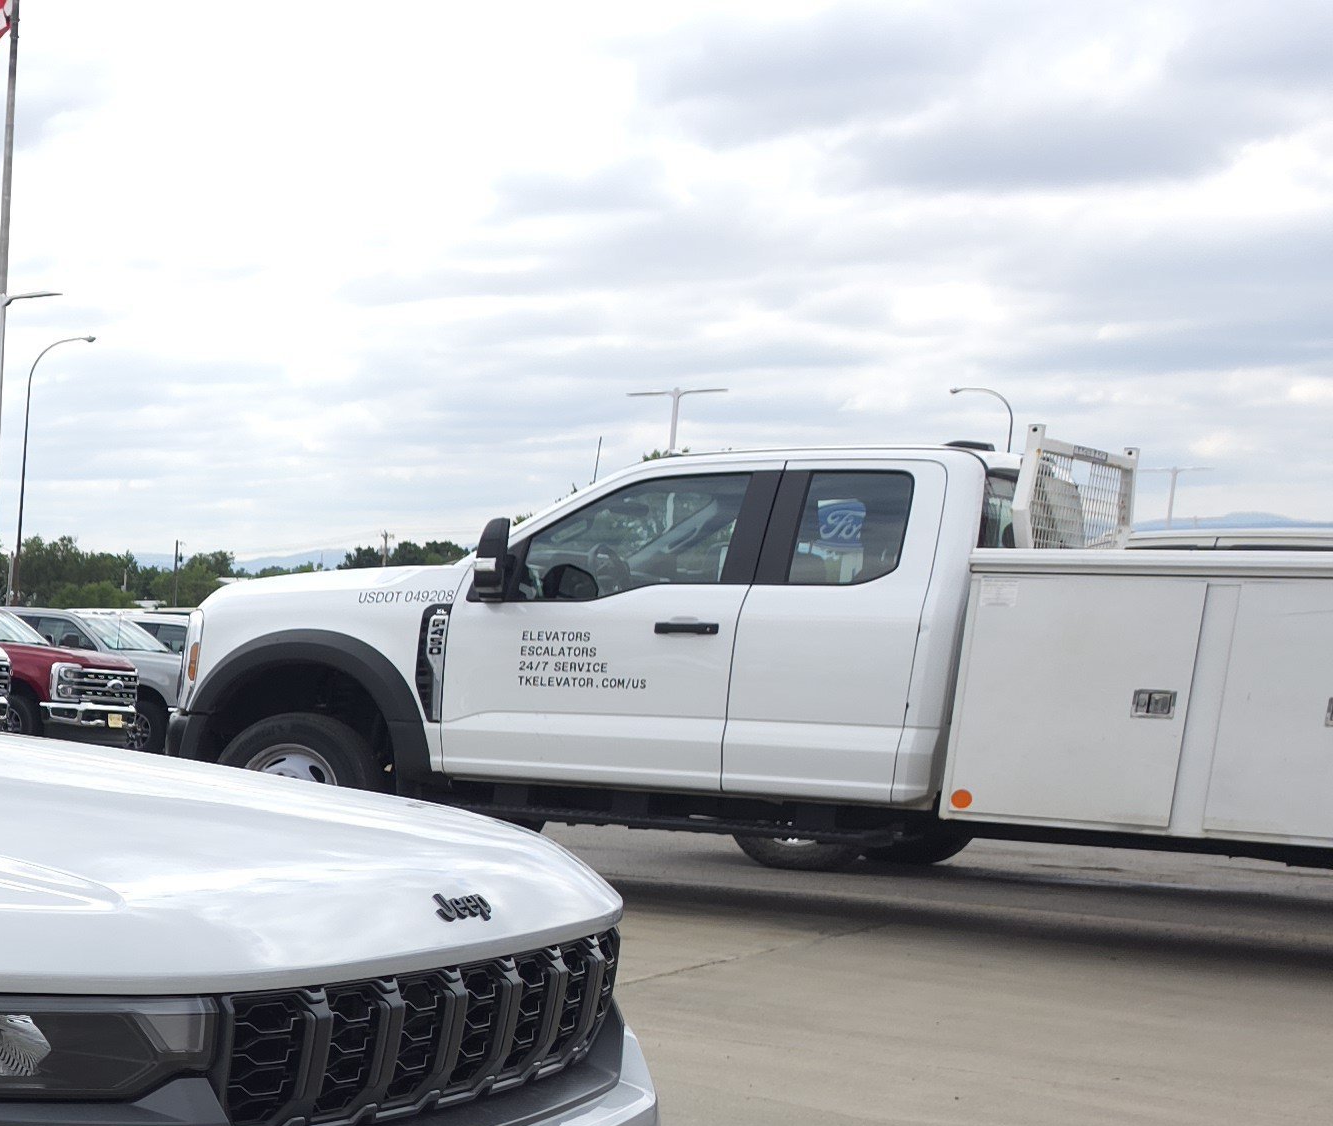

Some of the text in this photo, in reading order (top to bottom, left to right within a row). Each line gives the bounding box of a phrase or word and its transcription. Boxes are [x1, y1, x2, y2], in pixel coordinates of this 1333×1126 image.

[358, 589, 455, 604] USDOT 049208
[521, 630, 591, 642] ELEVATORS
[520, 645, 597, 657] ESCALATORS
[518, 660, 608, 673] 24/7 SERVICE
[517, 675, 647, 689] TKELEVATOR.COM/US
[432, 893, 492, 922] Jeep
